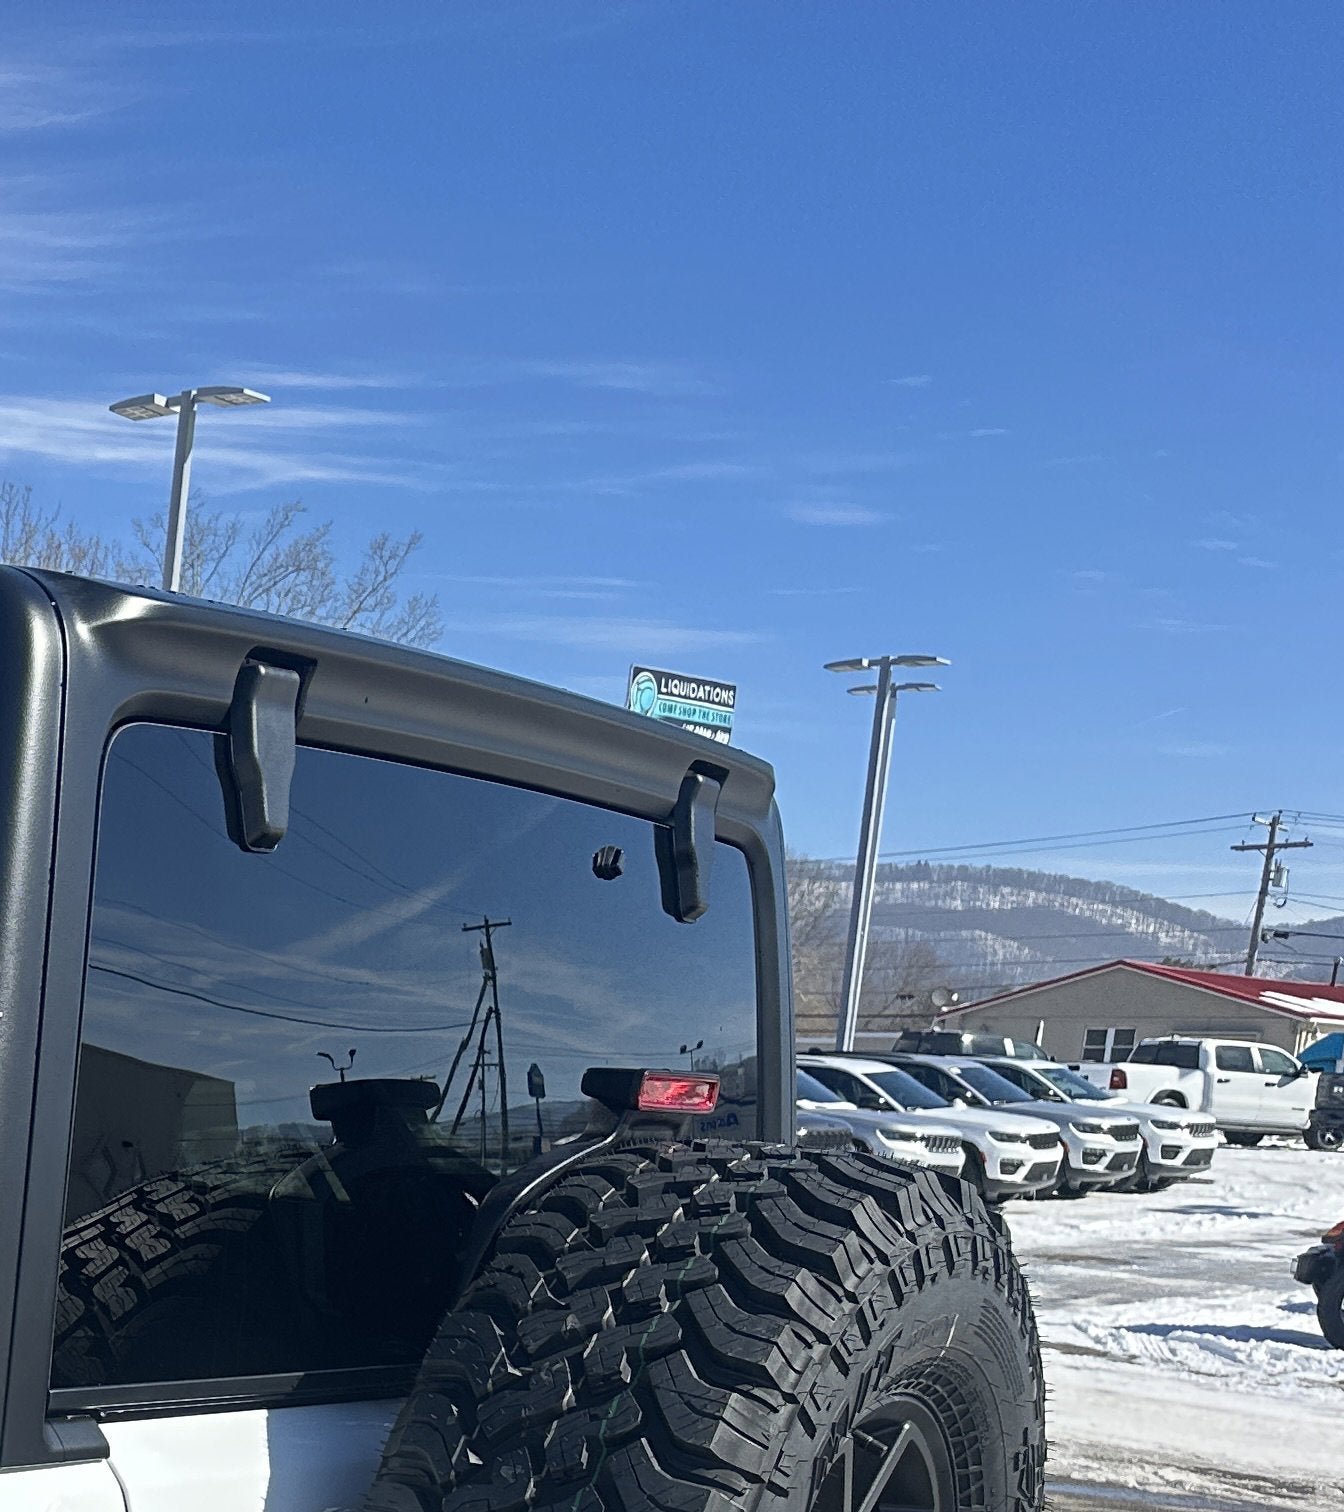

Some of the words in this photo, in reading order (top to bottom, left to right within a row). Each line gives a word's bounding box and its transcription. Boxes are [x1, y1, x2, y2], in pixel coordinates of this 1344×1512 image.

[660, 677, 735, 706] LIQUIDATIONS
[658, 702, 677, 714] COME
[678, 705, 697, 718] SHOP
[698, 710, 710, 721] THE
[711, 712, 732, 725] STORE
